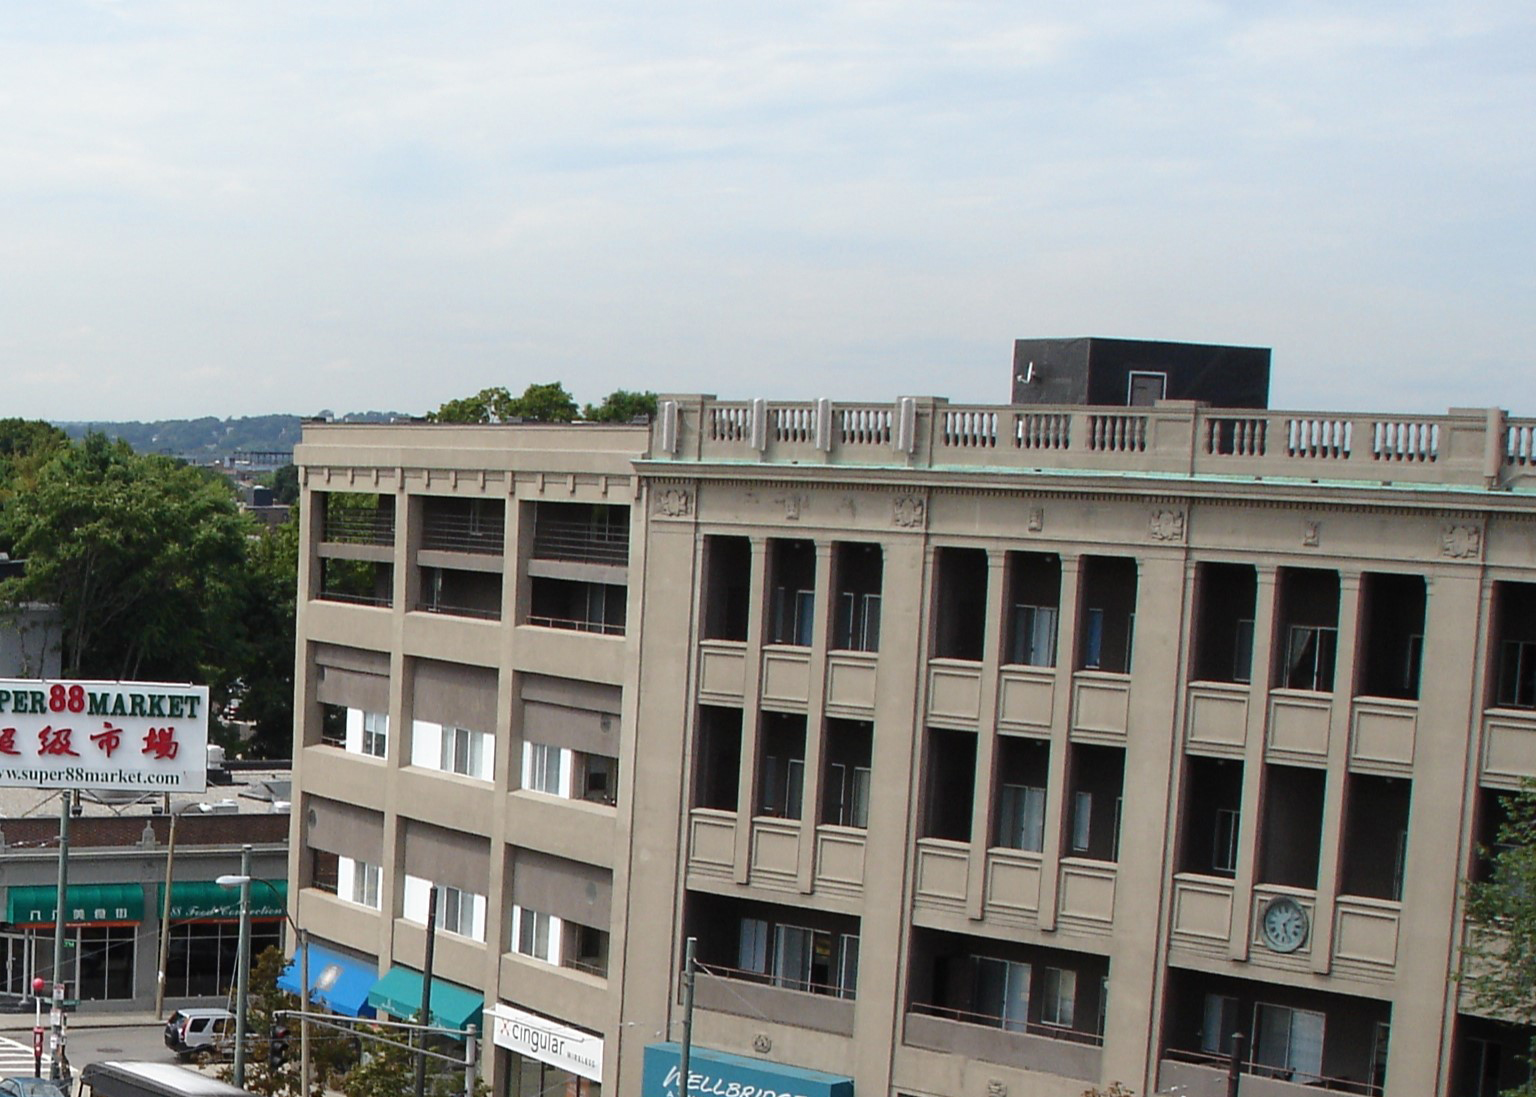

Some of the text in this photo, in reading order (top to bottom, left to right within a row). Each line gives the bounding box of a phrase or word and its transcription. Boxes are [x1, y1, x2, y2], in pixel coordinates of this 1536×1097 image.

[48, 683, 85, 713] 88
[87, 692, 201, 719] MARKET
[220, 906, 282, 916] Conection
[512, 1024, 565, 1056] cingular
